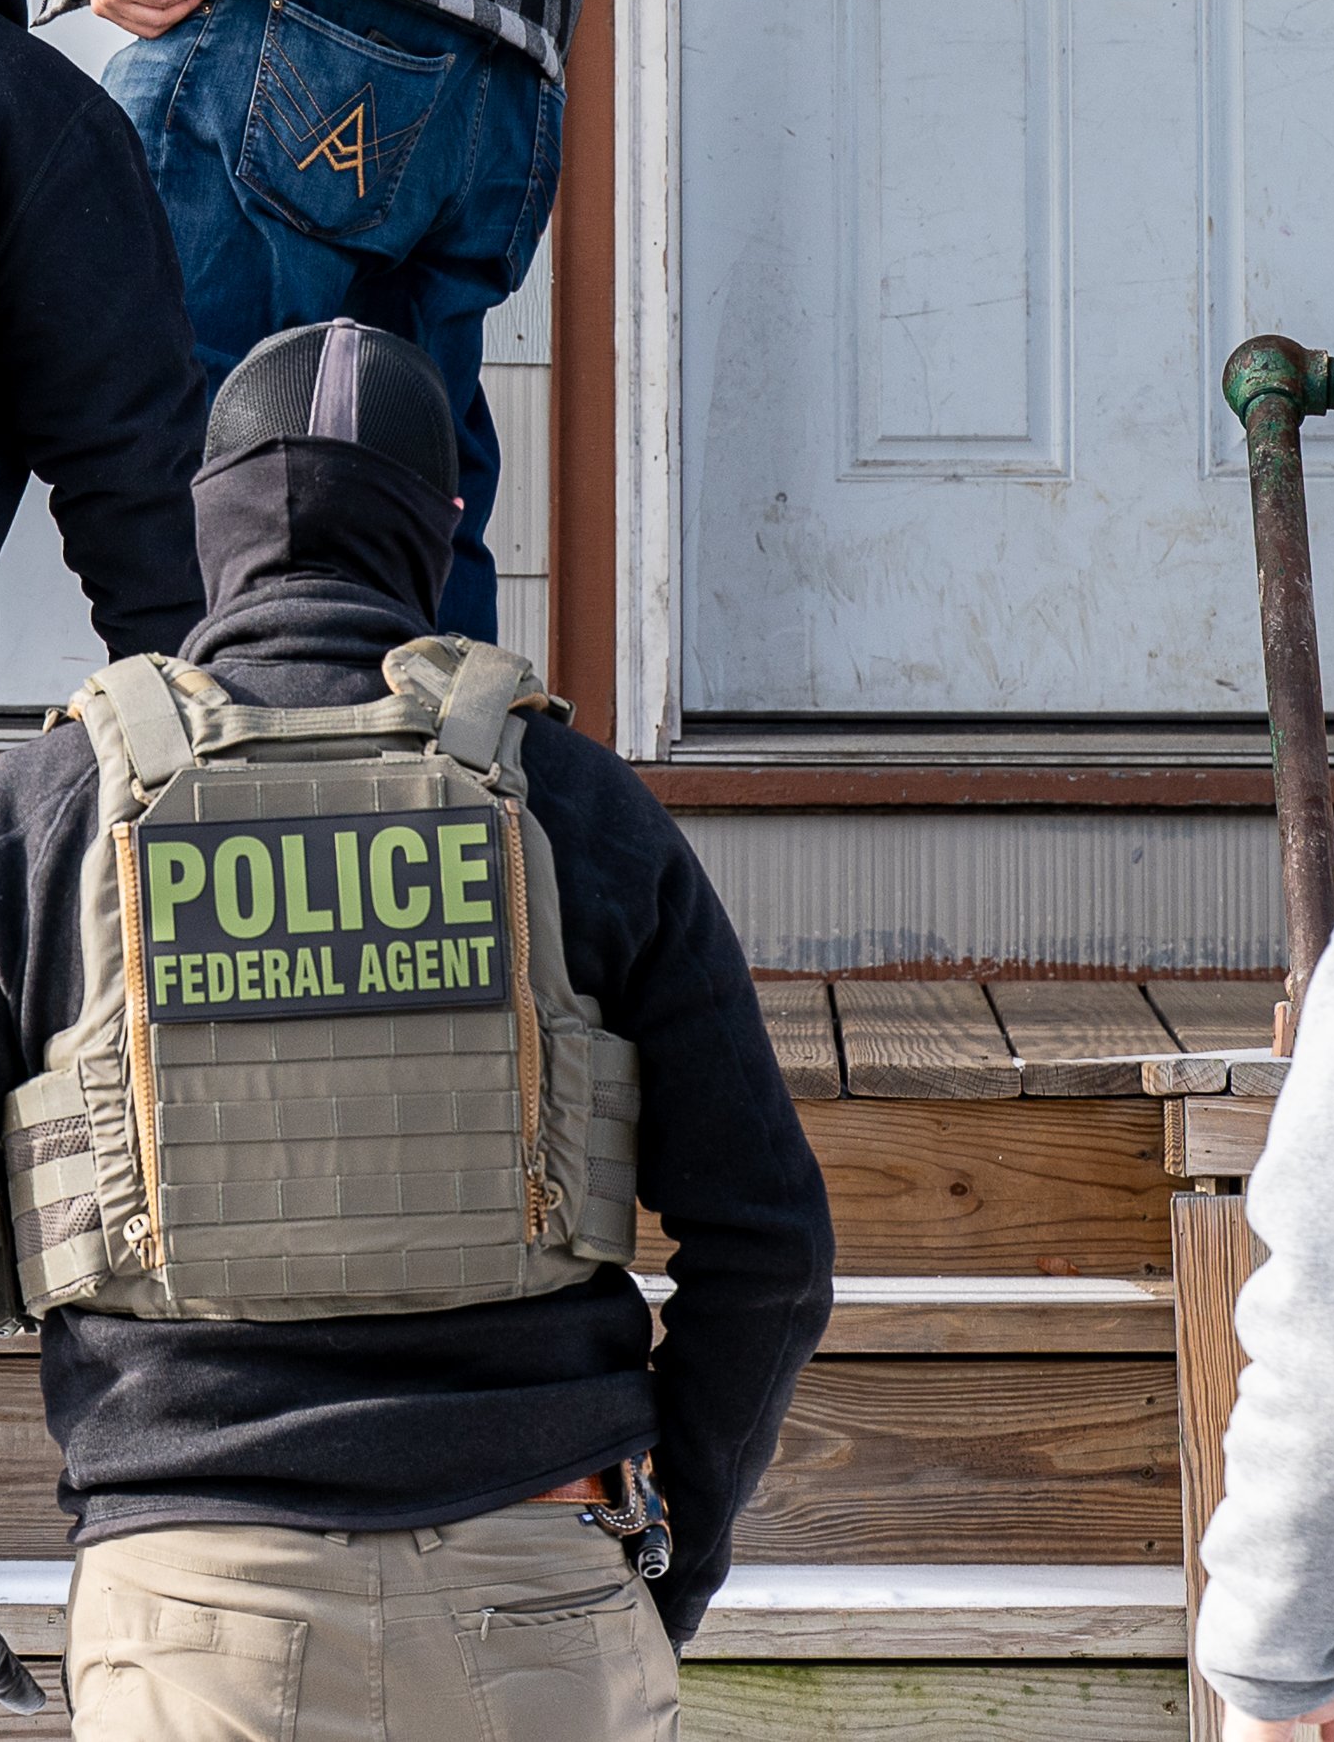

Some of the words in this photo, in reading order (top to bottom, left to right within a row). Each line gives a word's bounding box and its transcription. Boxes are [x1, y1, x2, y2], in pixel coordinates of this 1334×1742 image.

[147, 823, 494, 942] POLICE
[153, 945, 345, 1006] FEDERAL
[358, 936, 496, 994] AGENT
